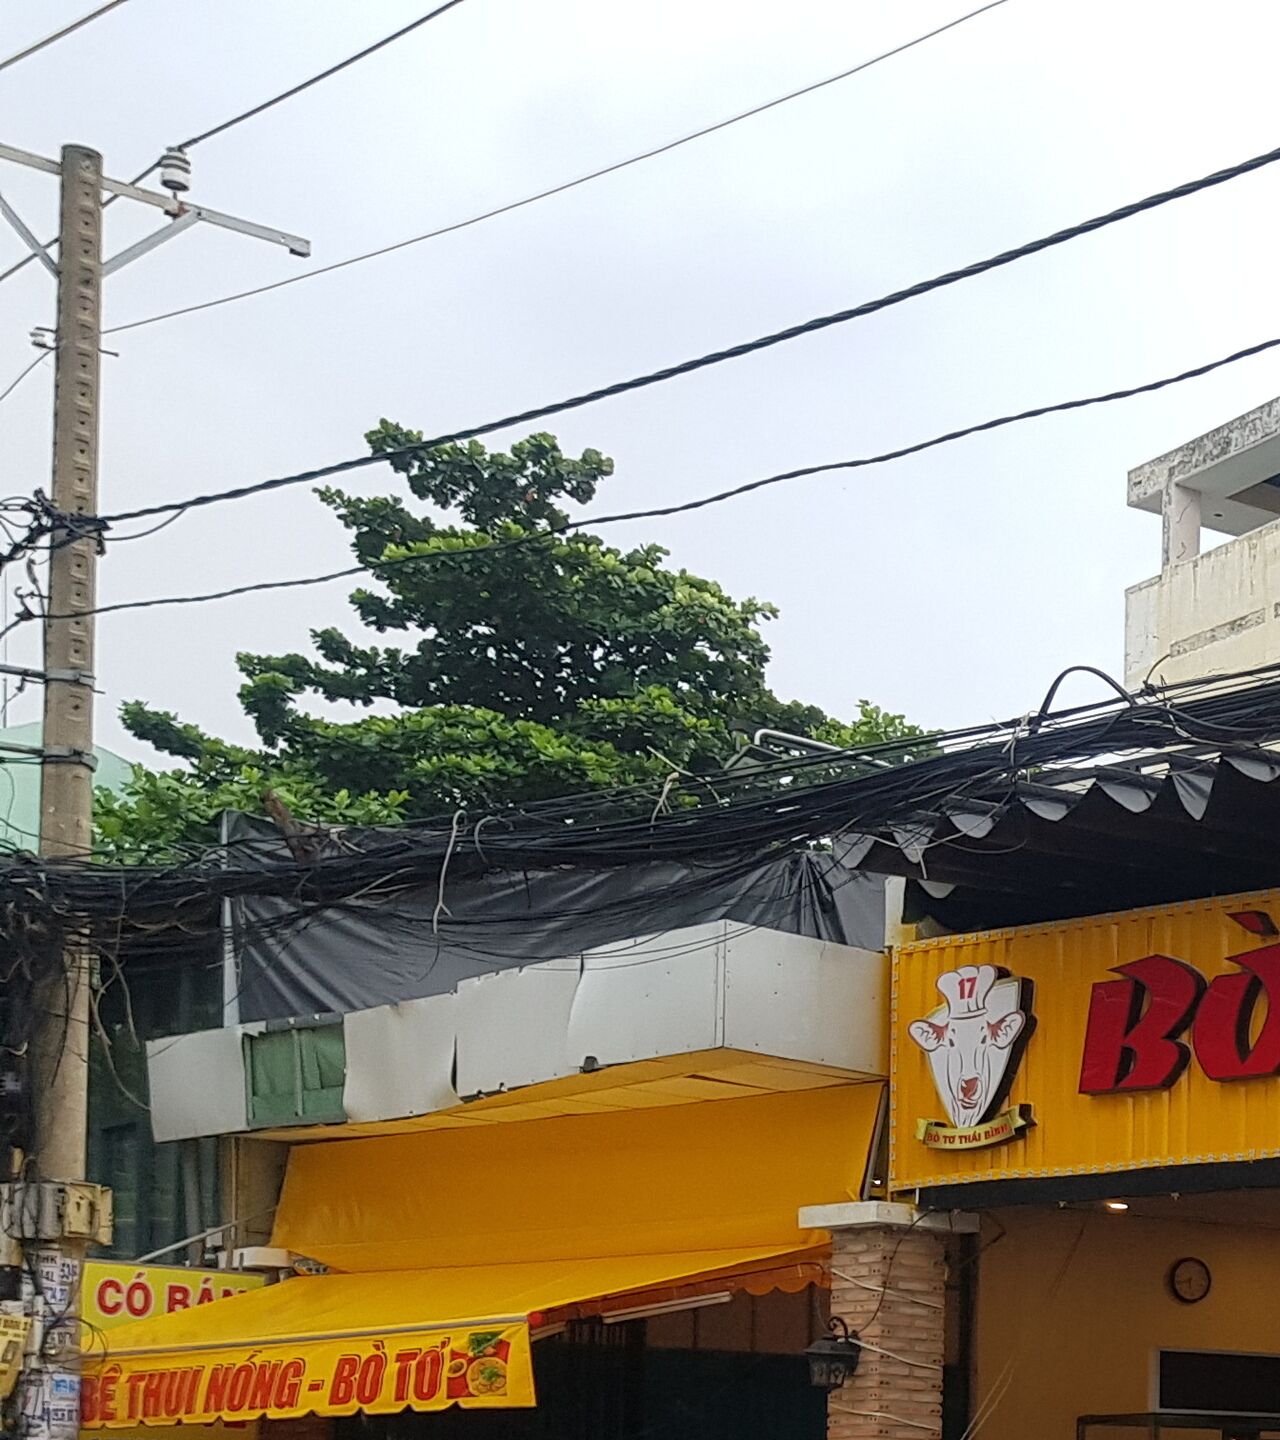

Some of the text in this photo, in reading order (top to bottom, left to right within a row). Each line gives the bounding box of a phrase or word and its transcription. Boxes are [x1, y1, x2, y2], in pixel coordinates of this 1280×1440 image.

[958, 977, 977, 1000] 17
[97, 1272, 154, 1317] CÓ
[167, 1277, 248, 1314] BÁ
[127, 1366, 206, 1420] THUI
[203, 1350, 306, 1413] NÓNG
[328, 1339, 387, 1406] BÒ
[394, 1336, 451, 1402] TƠ
